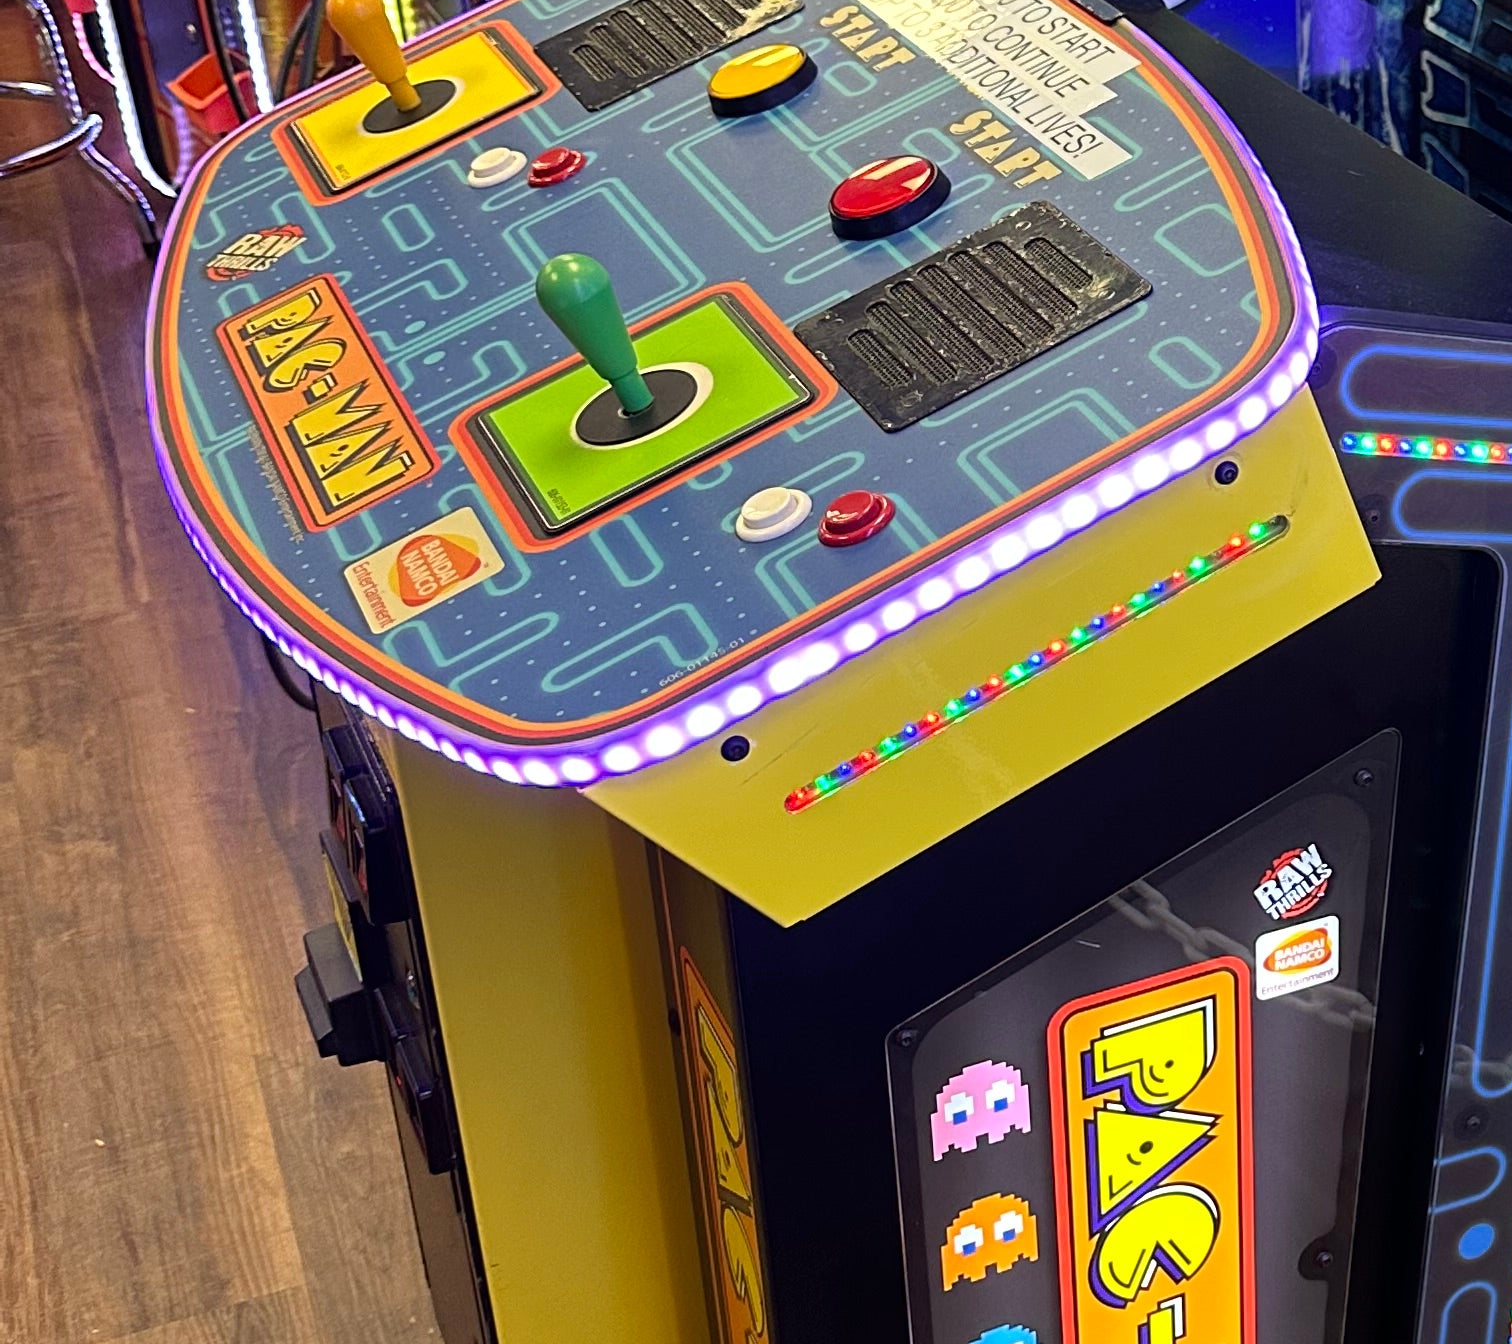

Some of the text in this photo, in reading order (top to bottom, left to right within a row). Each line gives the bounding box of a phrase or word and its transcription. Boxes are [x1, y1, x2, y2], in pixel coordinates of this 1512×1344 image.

[820, 6, 917, 71] START
[959, 5, 998, 31] TO
[983, 23, 1090, 98] CONTINUE
[1038, 17, 1116, 64] START
[893, 2, 930, 28] TO
[916, 24, 934, 38] 3
[932, 29, 1041, 113] ADDITIONAL
[1025, 104, 1103, 158] LIVES!
[950, 111, 1063, 188] START
[206, 254, 279, 272] THRILLS
[223, 233, 308, 258] RAW
[237, 287, 415, 516] PAC-MAN
[400, 550, 438, 596] NAMCO
[421, 539, 459, 586] BANDAI
[352, 561, 396, 629] Entertainment
[1253, 843, 1323, 910] RAW
[1266, 863, 1332, 920] THRILLS
[1274, 938, 1325, 959] BANDAI
[1274, 948, 1326, 971] NAMCO
[1261, 968, 1334, 995] Entertainment
